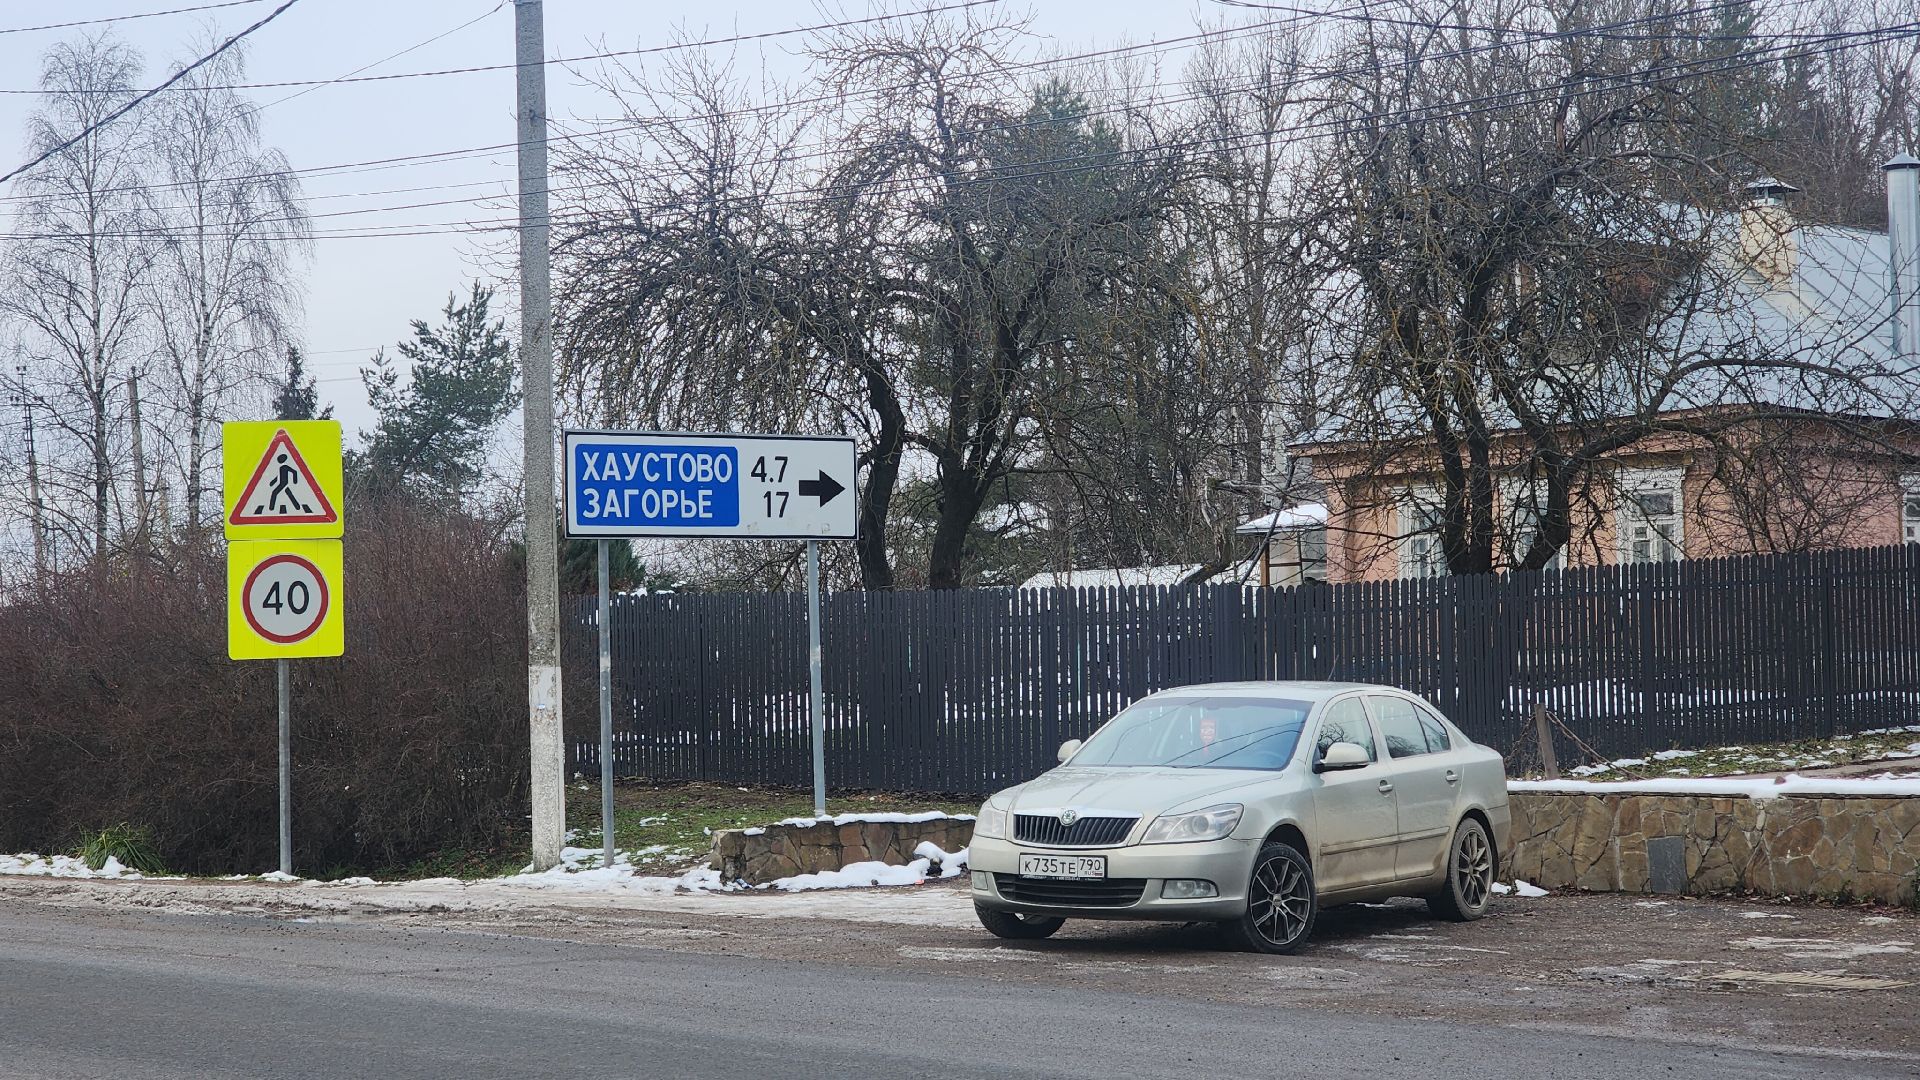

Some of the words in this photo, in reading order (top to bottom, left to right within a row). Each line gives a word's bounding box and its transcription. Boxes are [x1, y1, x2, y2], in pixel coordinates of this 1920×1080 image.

[582, 452, 732, 482] ХАУСТОВО
[751, 456, 788, 483] 4.7
[582, 489, 713, 518] ЗАГОРЬЕ
[763, 491, 790, 518] 17
[262, 580, 310, 615] 40
[1079, 858, 1101, 871] 790
